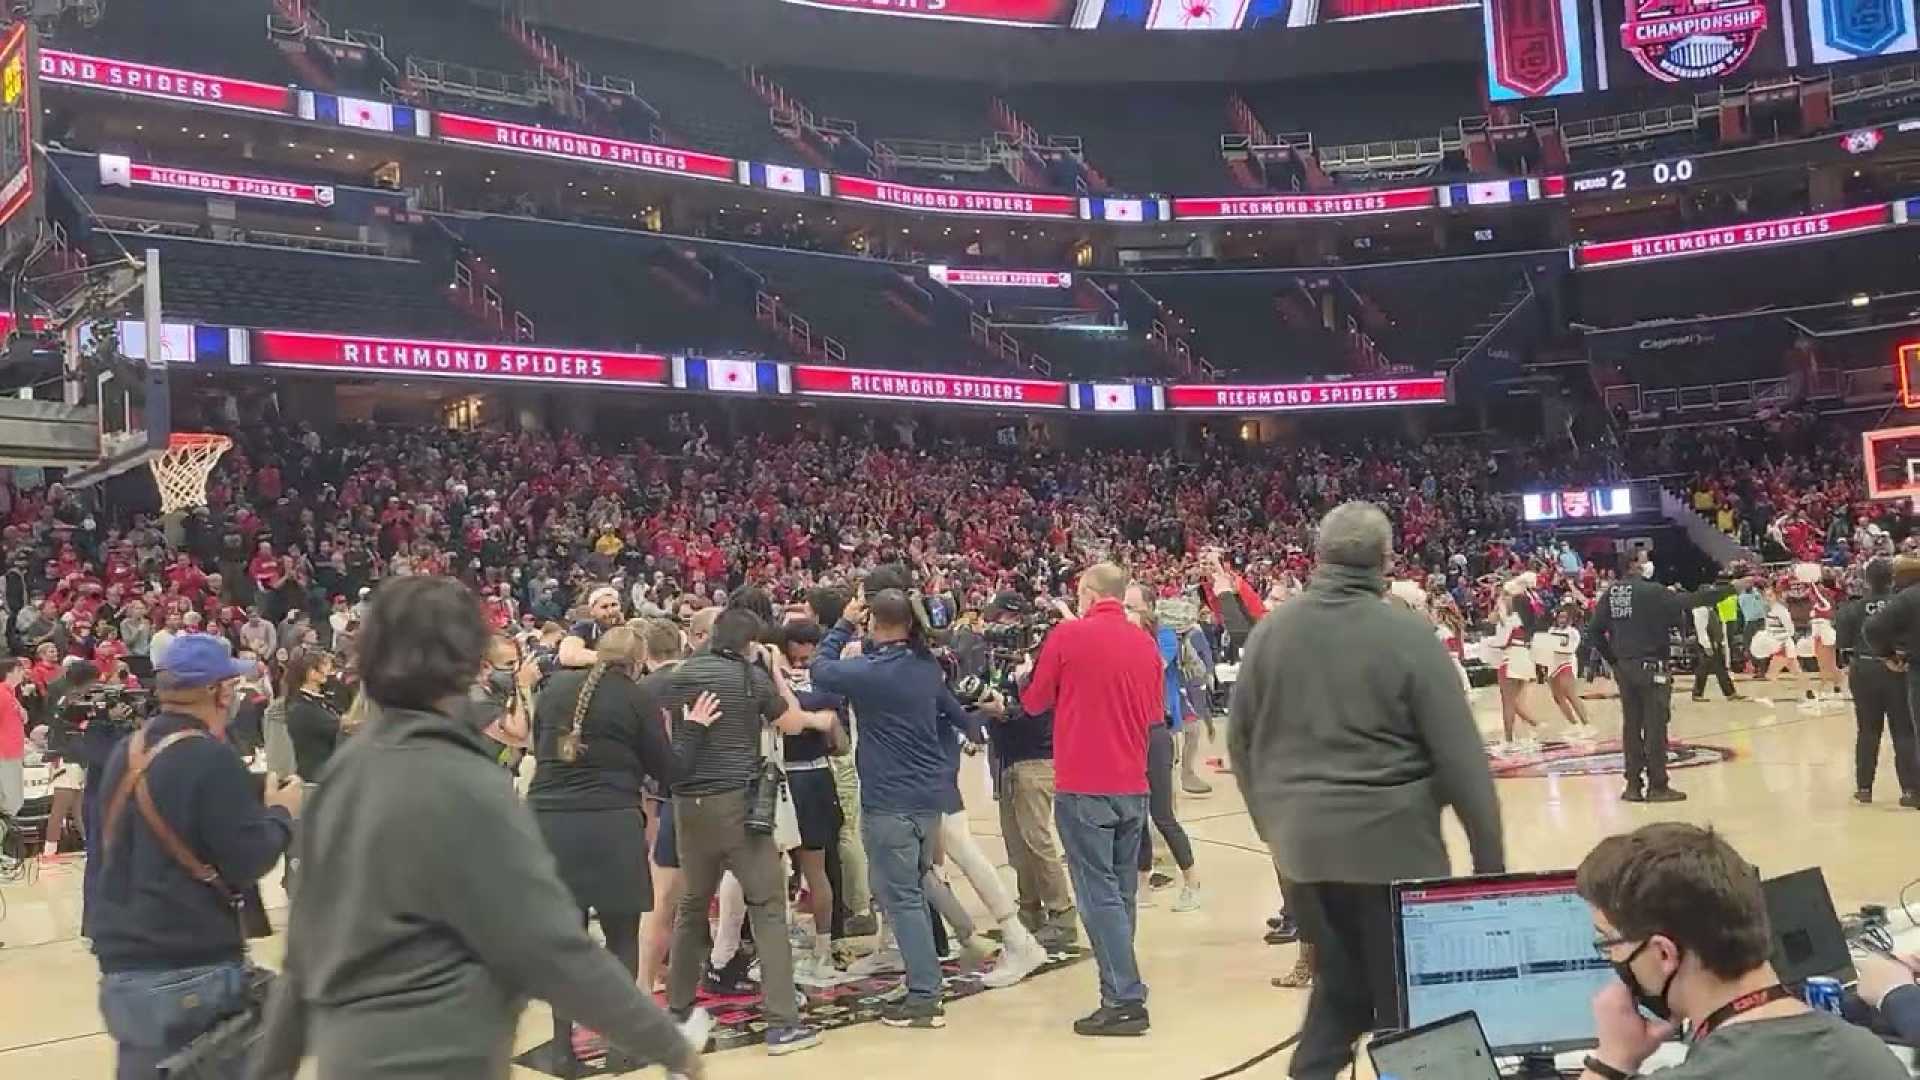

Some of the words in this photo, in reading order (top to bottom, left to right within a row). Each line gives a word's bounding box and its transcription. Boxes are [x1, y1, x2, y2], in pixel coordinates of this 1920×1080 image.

[1636, 9, 1762, 40] CHAMPIONSHIP
[109, 67, 223, 99] SPIDERS
[497, 127, 601, 157] RICHMOND
[610, 147, 688, 170] SPIDERS
[150, 170, 232, 190] RICHMOND
[236, 179, 298, 198] SPIDERS
[1611, 168, 1627, 190] 2
[1653, 159, 1692, 184] 0.0
[876, 186, 959, 209] RICHMOND
[965, 196, 1034, 212] SPIDERS
[1220, 200, 1308, 216] RICHMOND
[1314, 196, 1386, 214] SPIDERS
[1631, 234, 1735, 257] RICHMOND
[1743, 218, 1830, 244] SPIDERS
[344, 343, 489, 370] RICHMOND
[501, 355, 603, 376] SPIDERS
[851, 374, 946, 397] RICHMOND
[953, 382, 1024, 401] SPIDERS
[1217, 388, 1312, 406] RICHMOND
[1319, 385, 1399, 403] SPIDERS
[1611, 607, 1633, 619] STAFF
